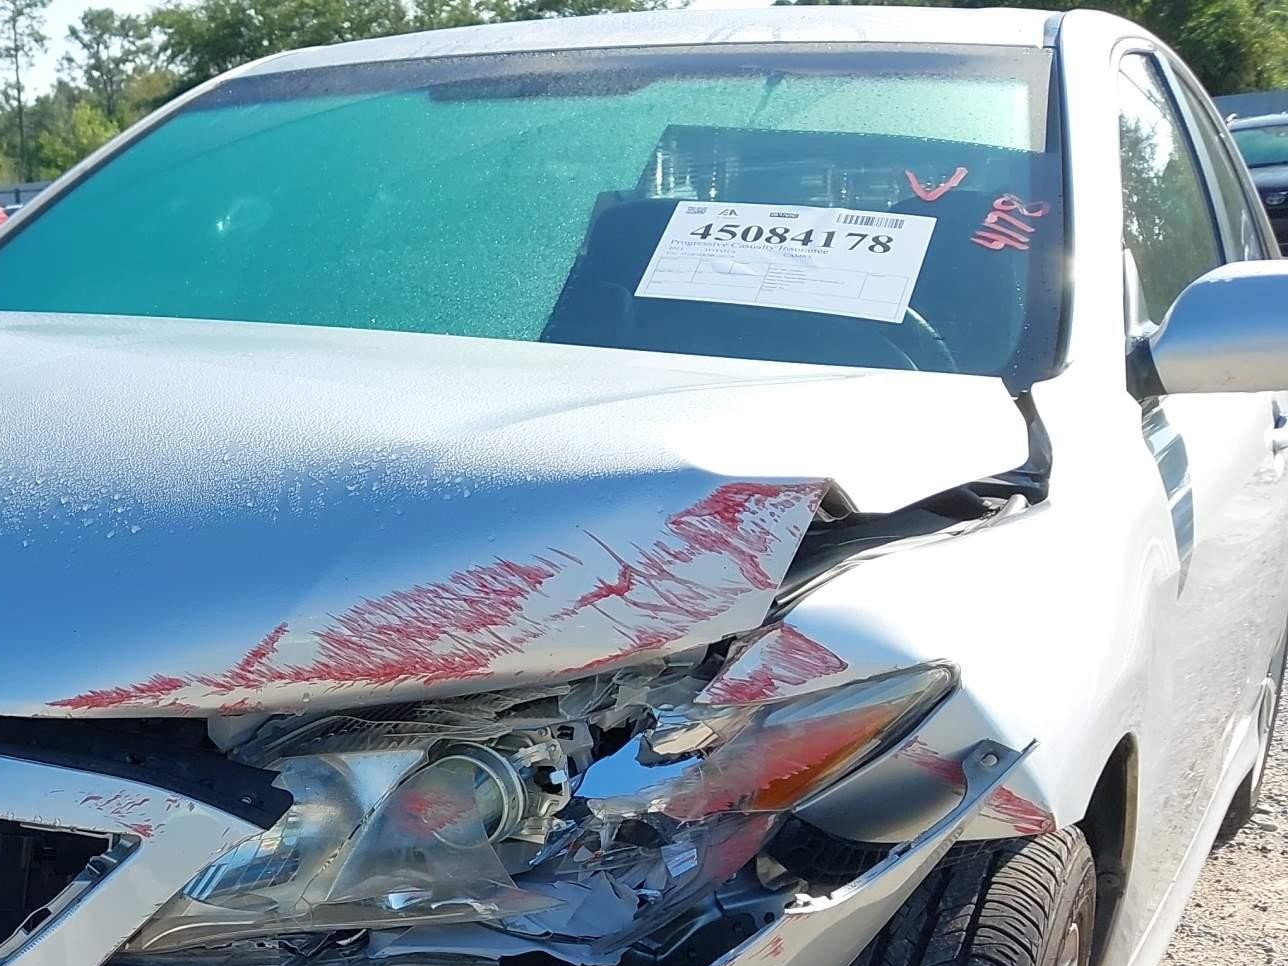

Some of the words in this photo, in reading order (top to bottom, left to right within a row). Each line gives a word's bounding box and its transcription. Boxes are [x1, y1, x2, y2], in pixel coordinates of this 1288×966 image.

[970, 193, 1050, 250] 4178
[671, 239, 729, 249] Progressive
[731, 243, 774, 251] Casualty
[779, 244, 829, 255] Insurance
[690, 223, 894, 254] 45084178
